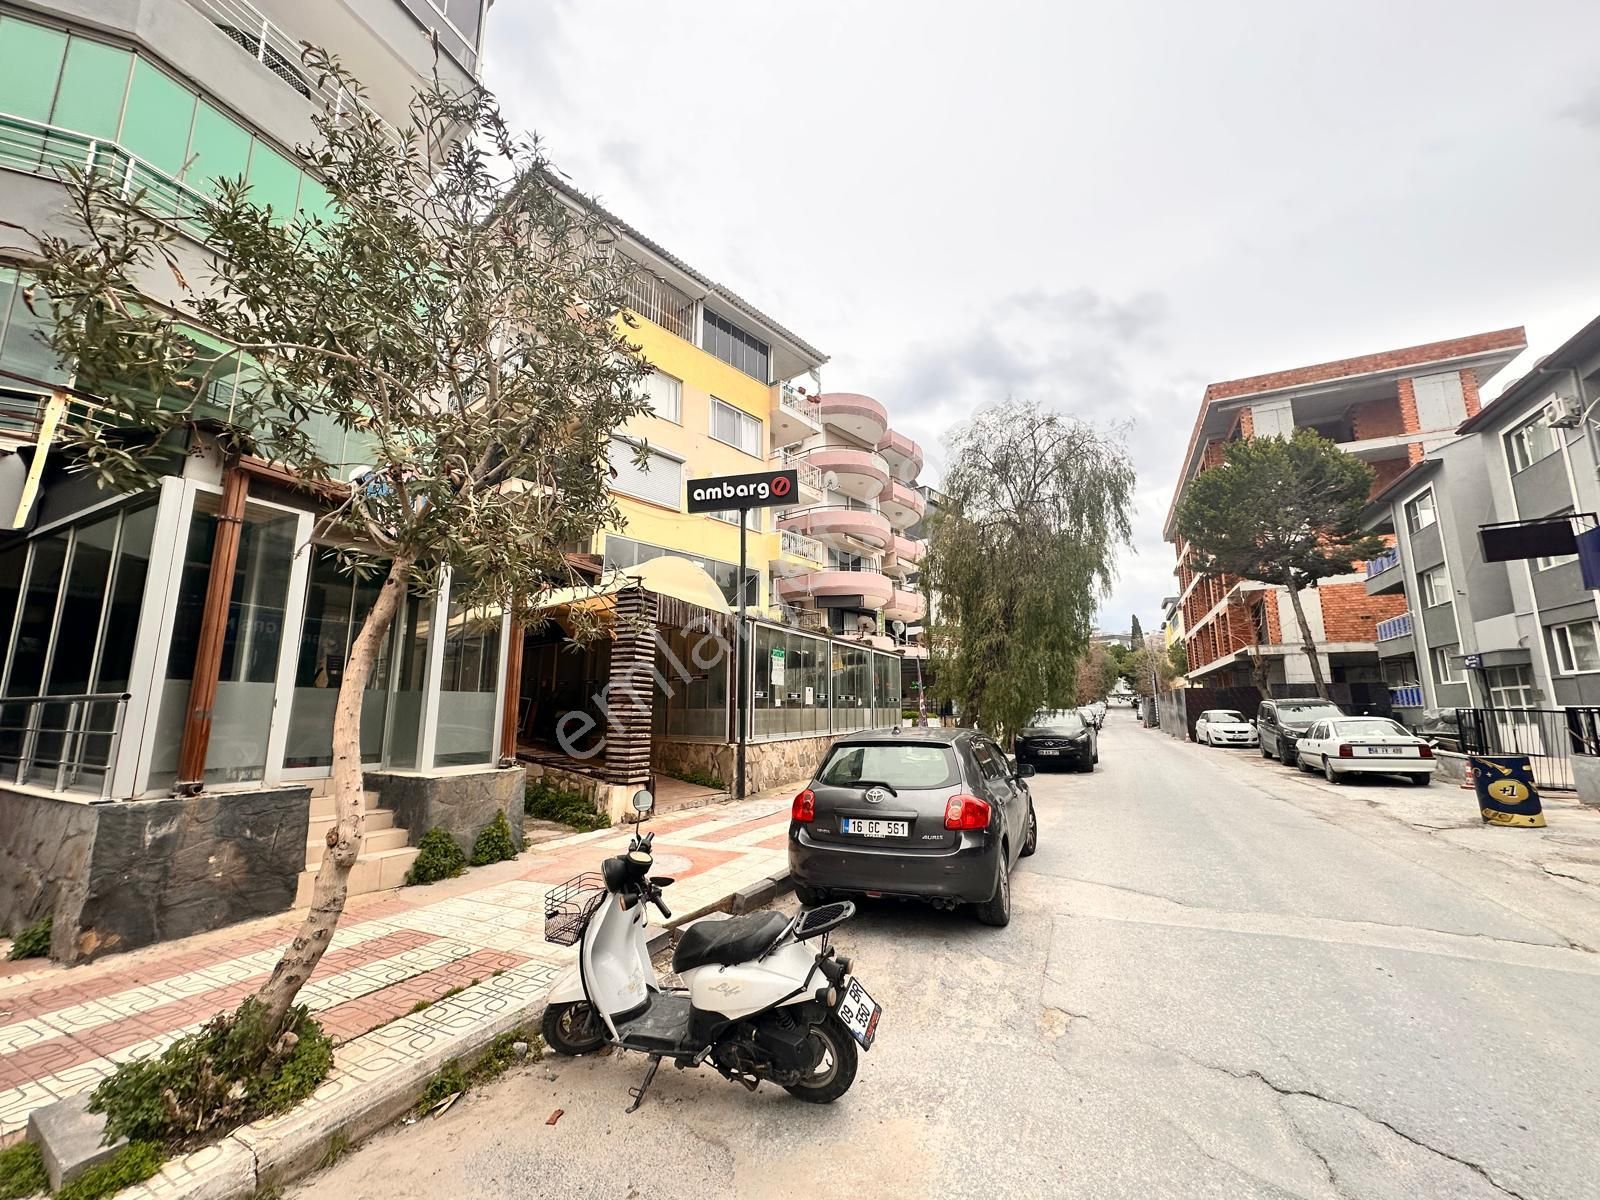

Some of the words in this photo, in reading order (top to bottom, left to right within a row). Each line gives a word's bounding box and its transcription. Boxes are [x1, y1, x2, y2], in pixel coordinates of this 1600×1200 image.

[693, 476, 791, 501] ambargo
[852, 821, 863, 833] 16
[868, 822, 880, 834] GC
[887, 823, 905, 836] 561
[840, 1004, 854, 1025] 09
[849, 983, 863, 1004] BR
[855, 1003, 871, 1028] 550
